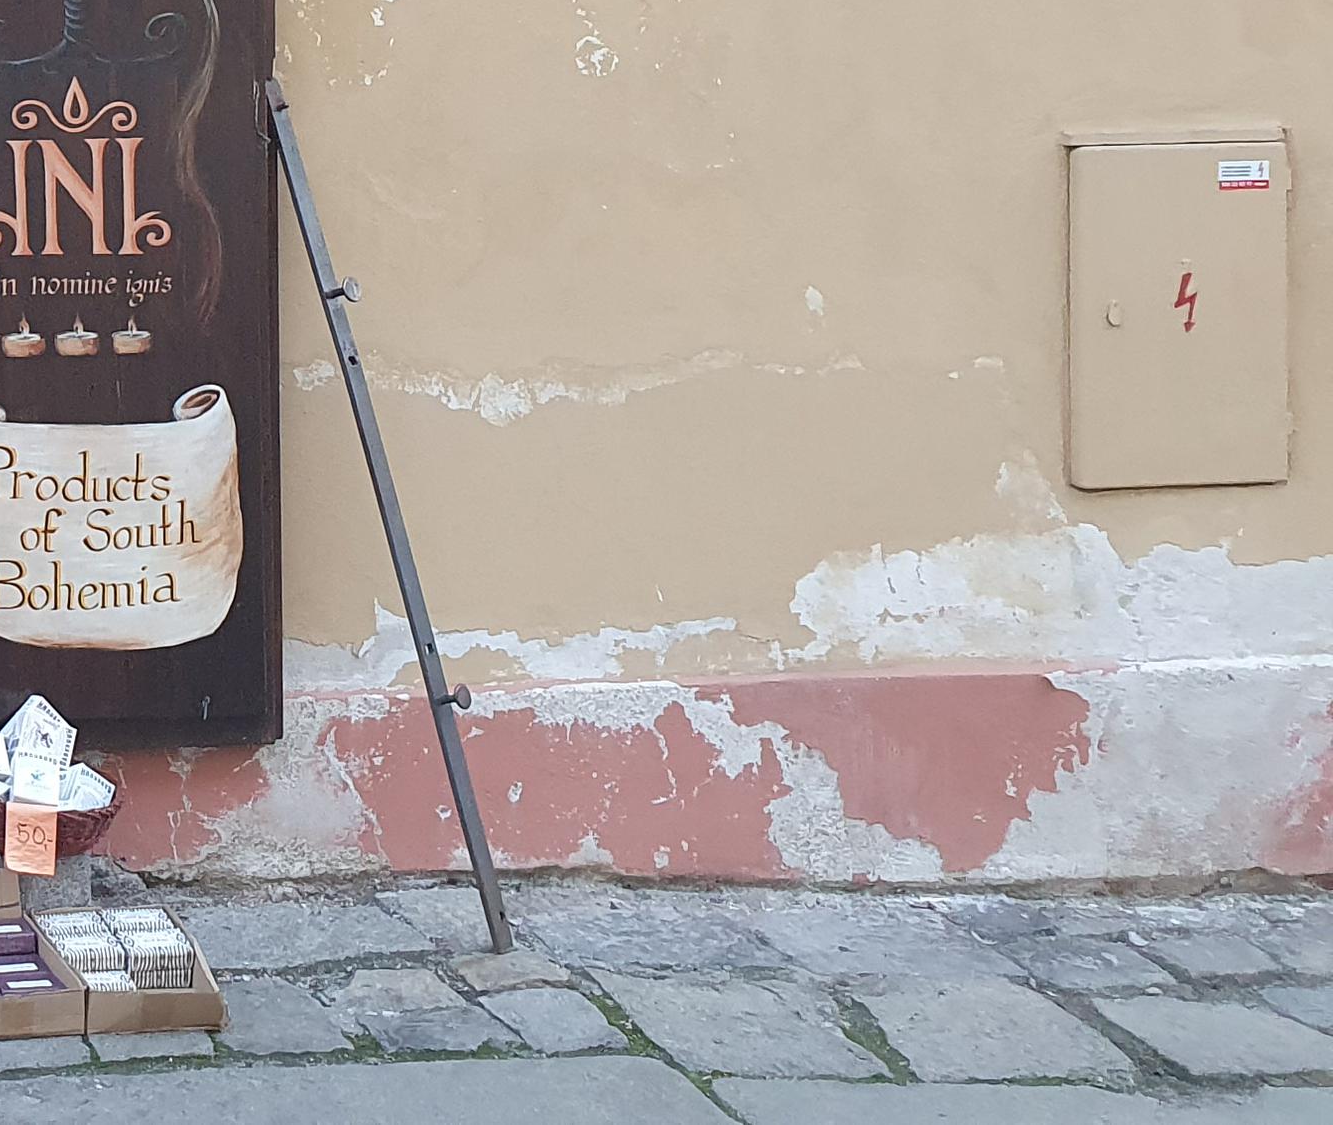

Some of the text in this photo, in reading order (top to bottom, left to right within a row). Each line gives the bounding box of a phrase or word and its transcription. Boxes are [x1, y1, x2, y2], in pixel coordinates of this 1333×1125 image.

[31, 271, 118, 296] nomine
[124, 270, 174, 307] ignis
[19, 497, 202, 554] of South
[16, 823, 53, 850] 50,-
